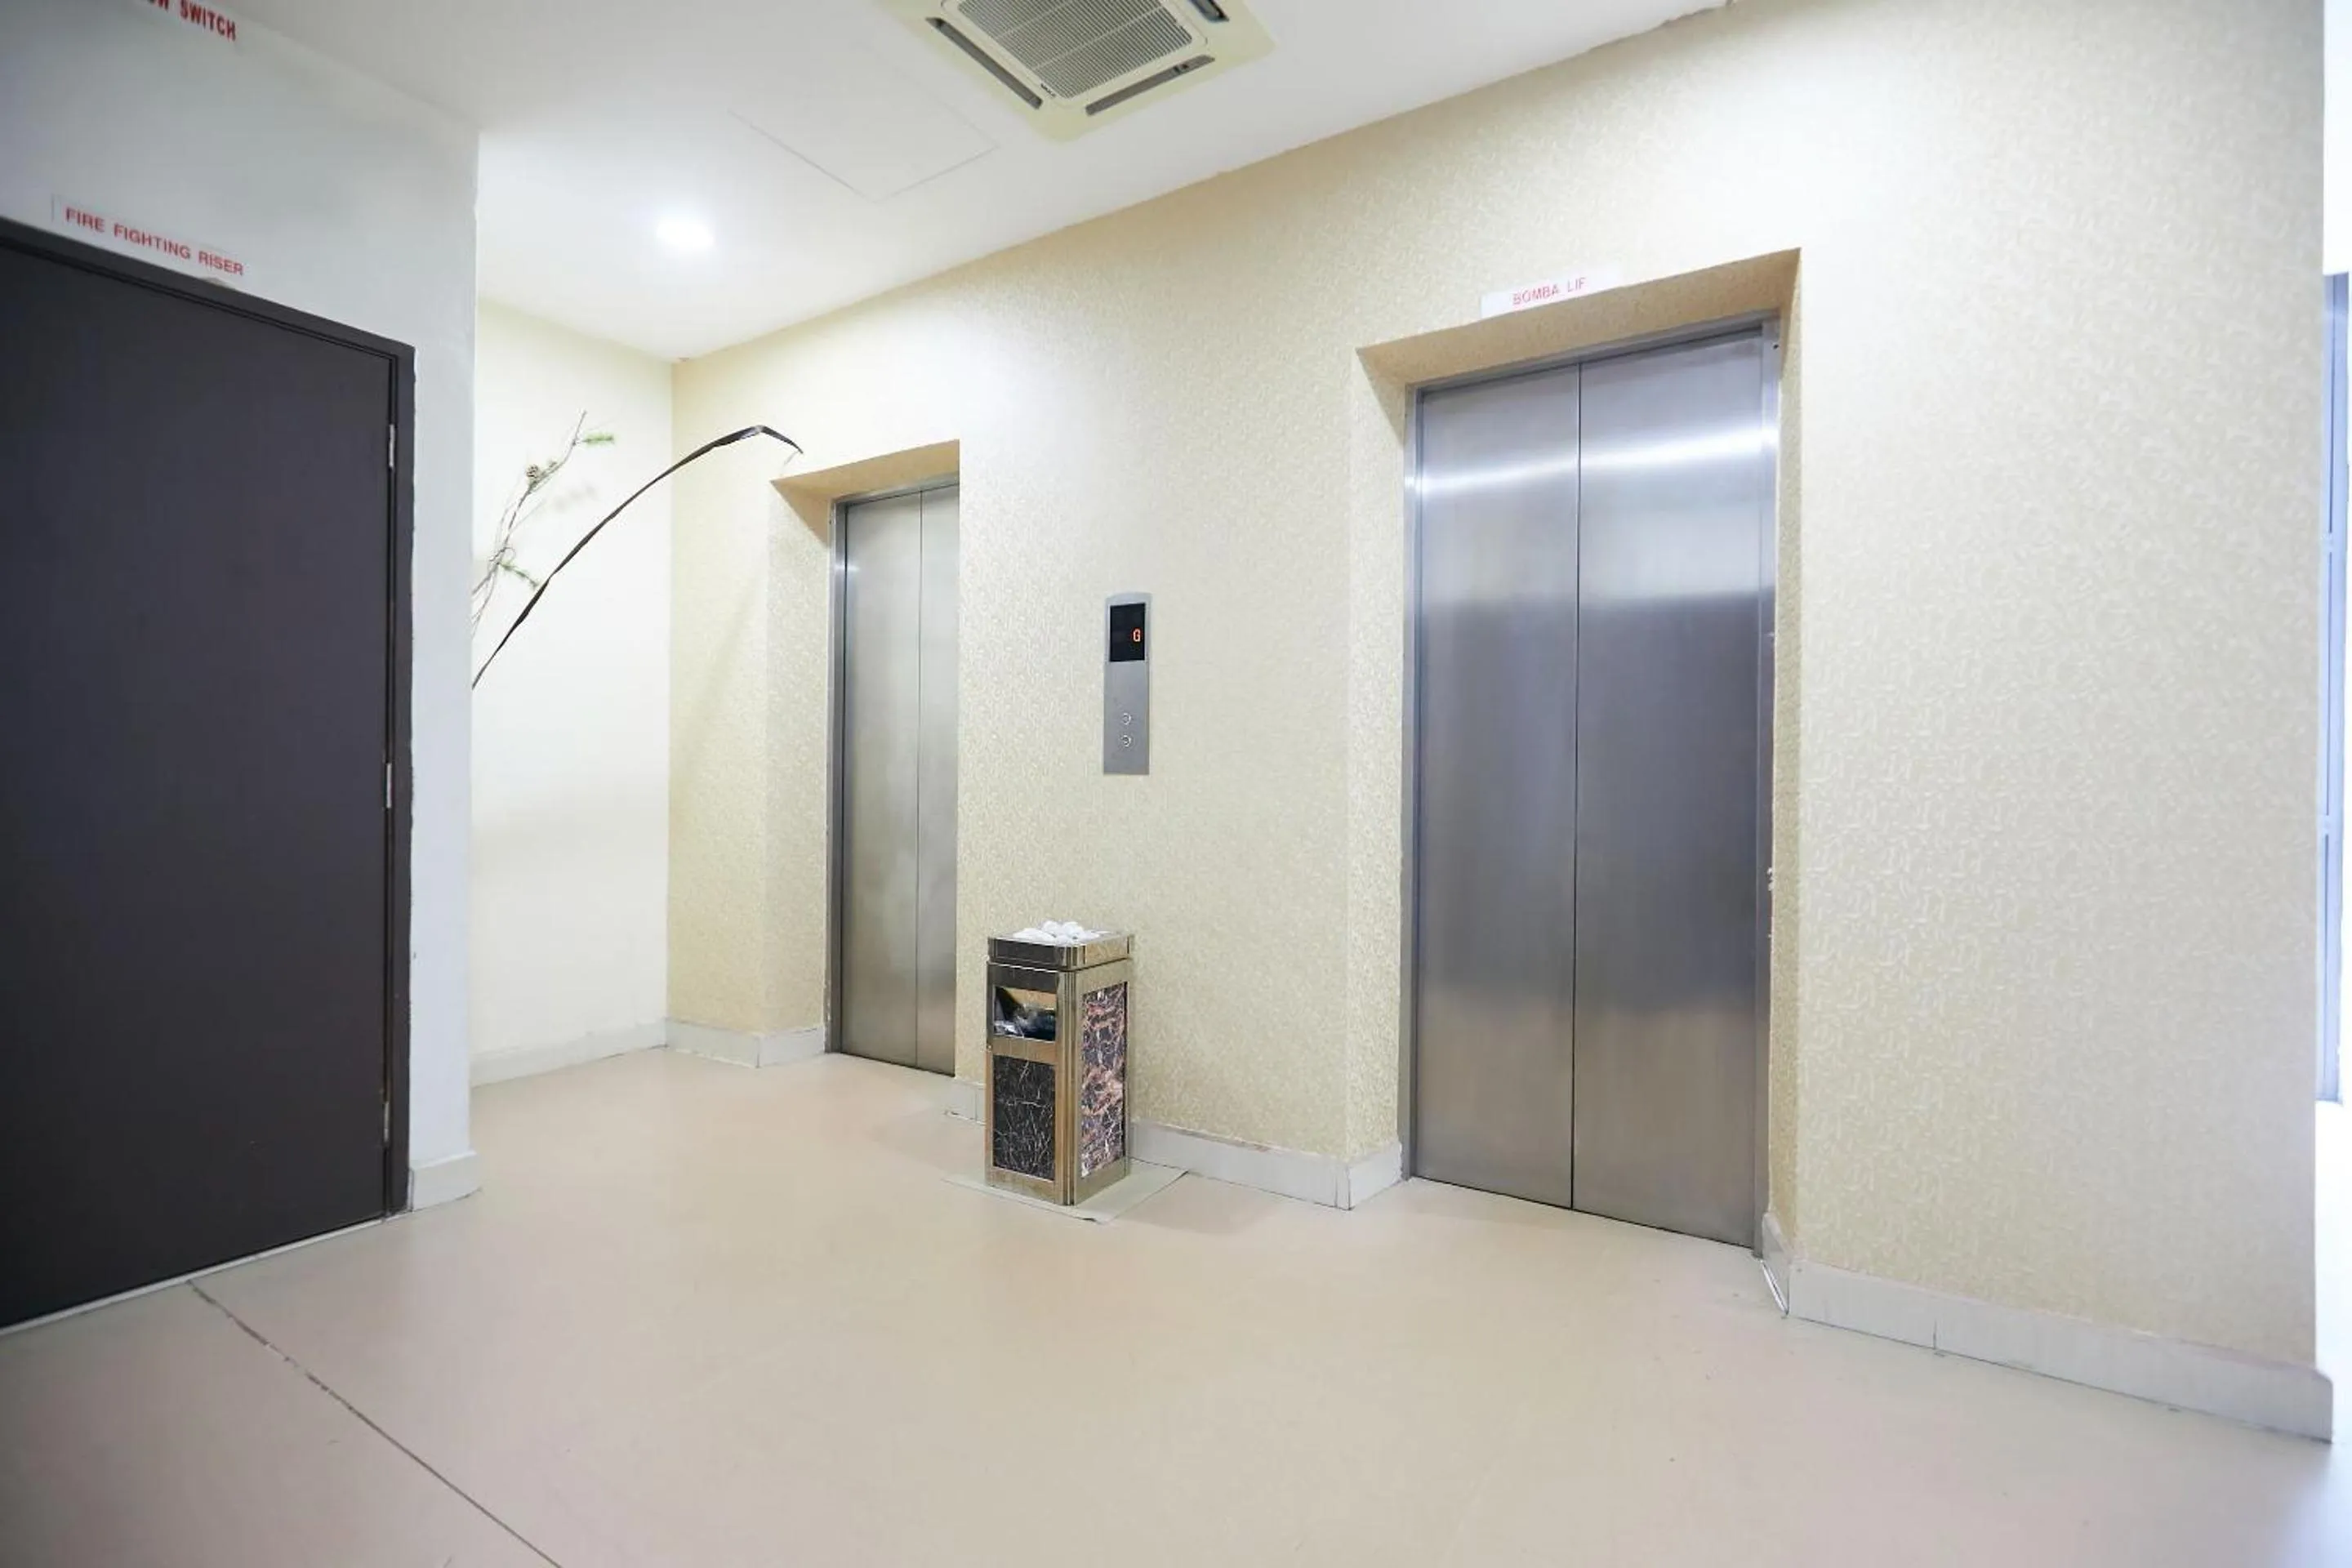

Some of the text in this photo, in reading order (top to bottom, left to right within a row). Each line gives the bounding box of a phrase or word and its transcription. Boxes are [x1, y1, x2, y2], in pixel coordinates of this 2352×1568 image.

[180, 0, 236, 42] SWITCH
[65, 207, 244, 275] FIRE FIGHTING RISER
[1512, 277, 1586, 305] BOMBA LIF
